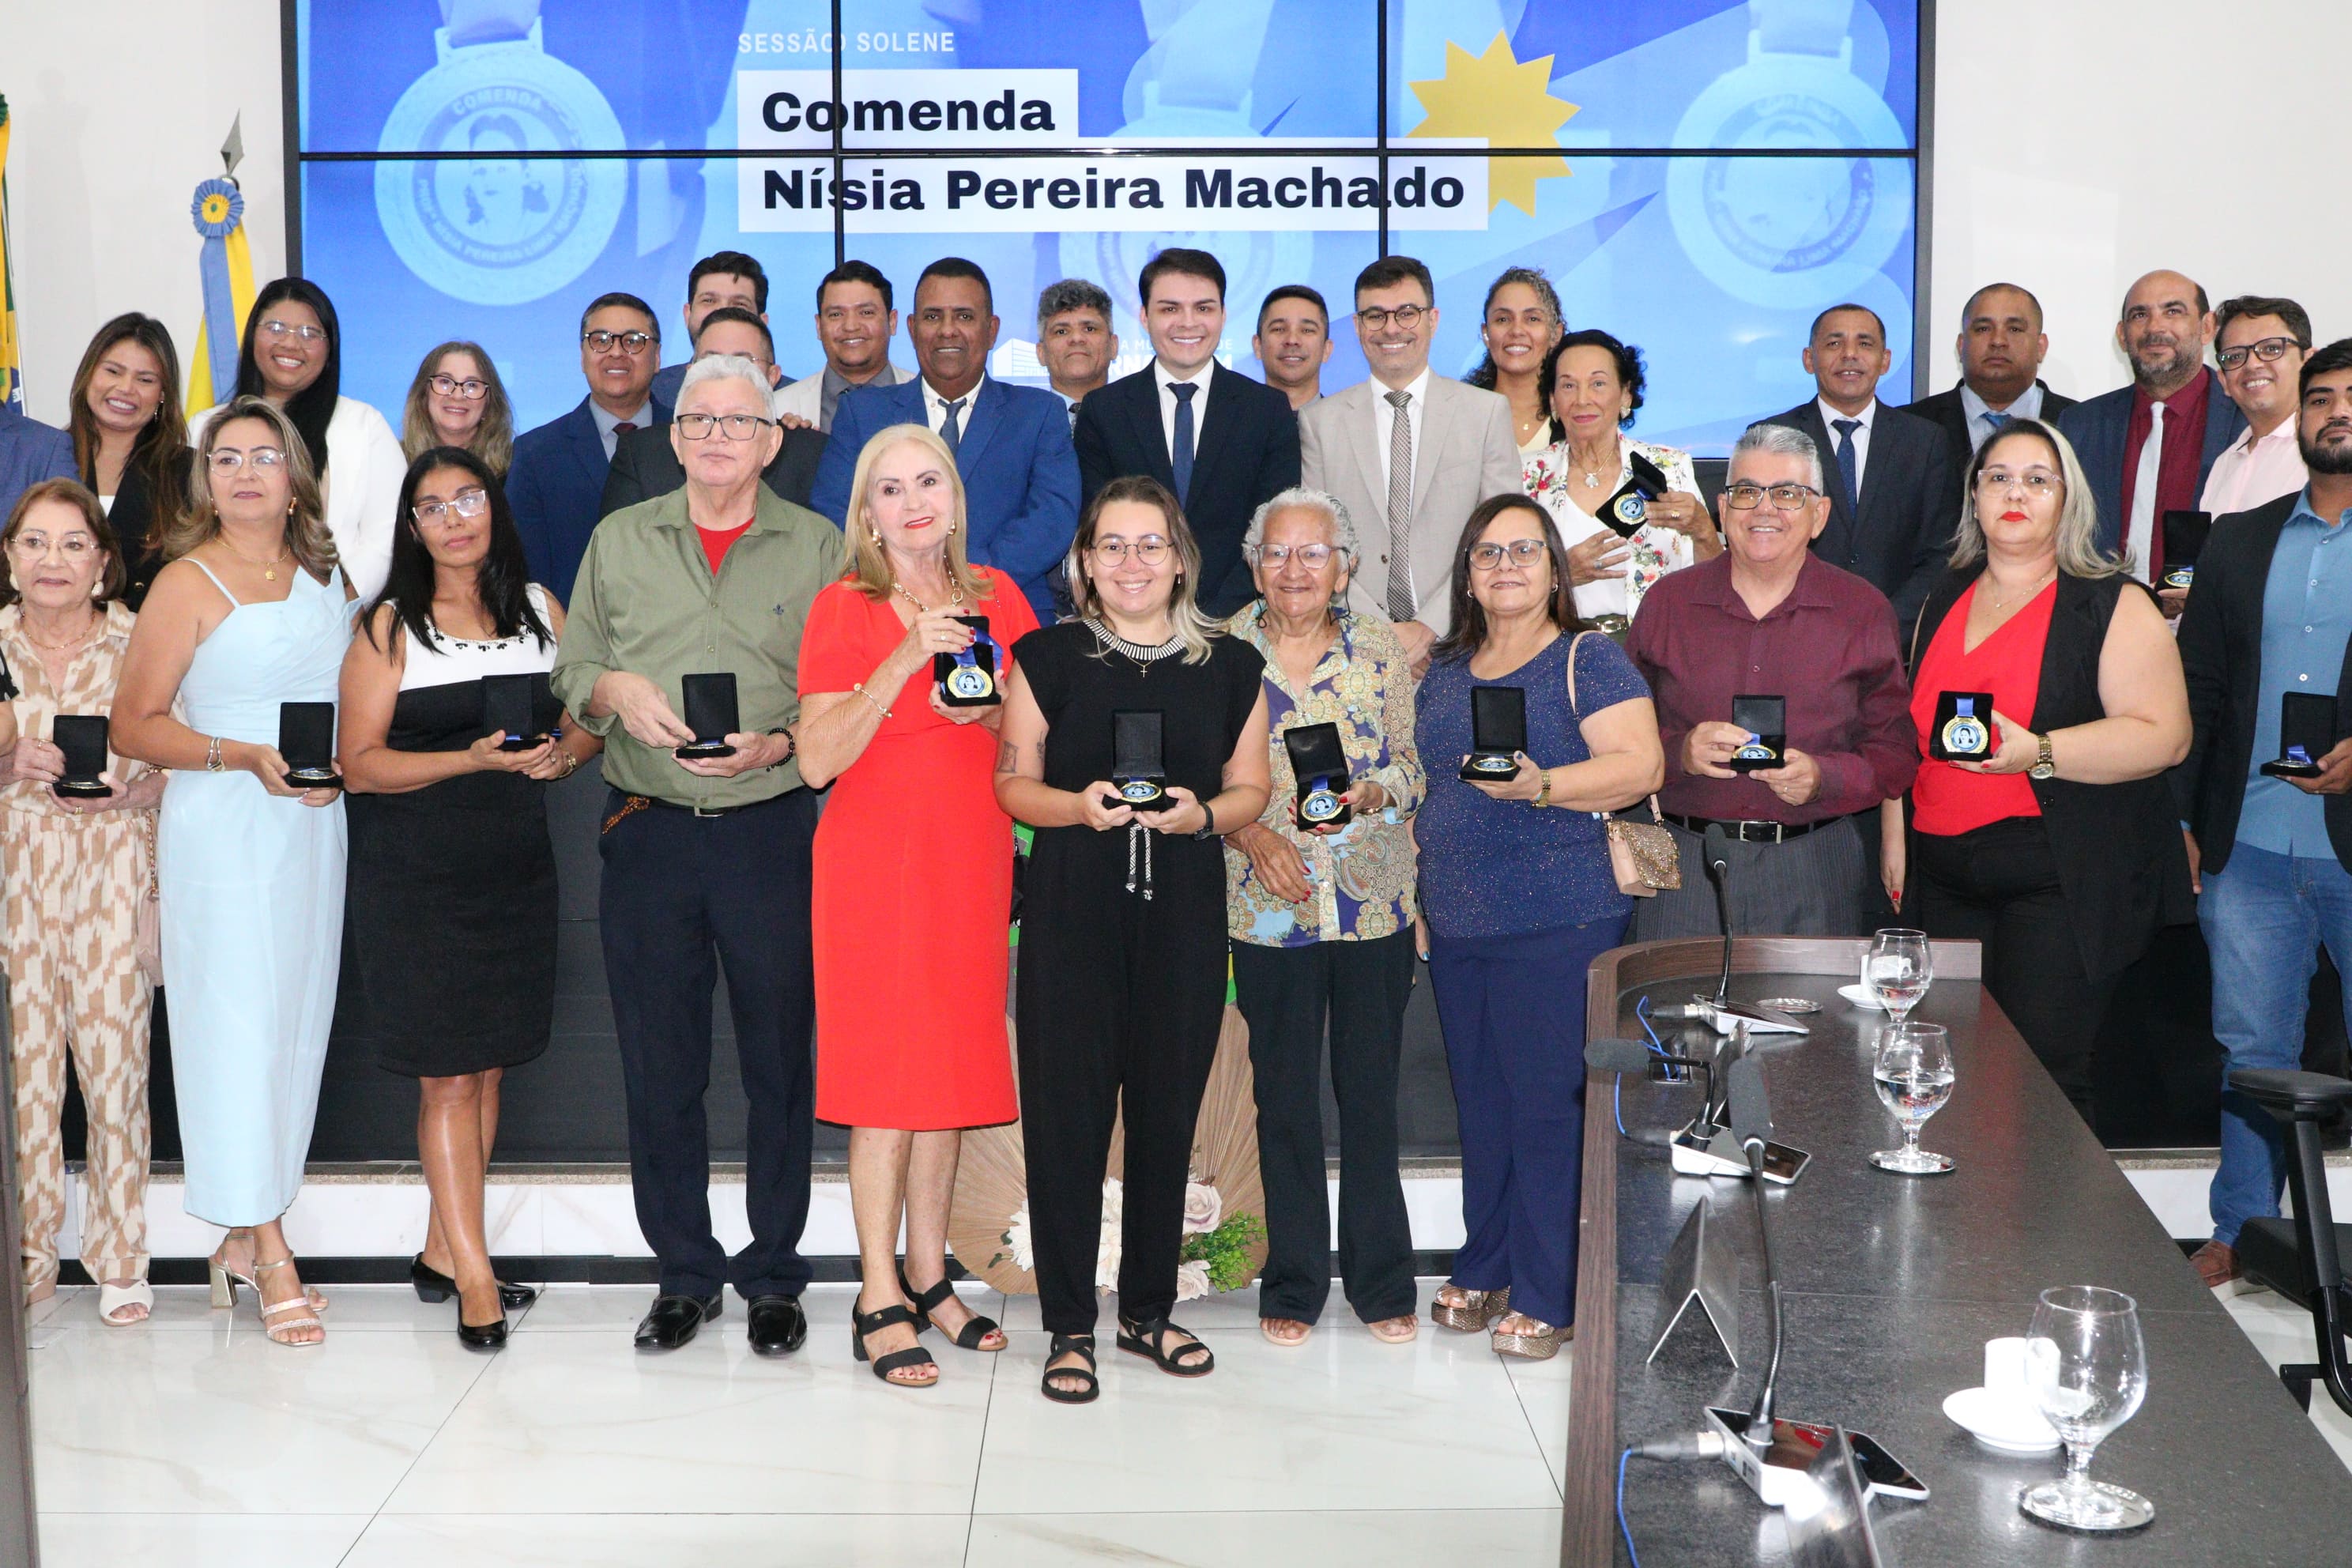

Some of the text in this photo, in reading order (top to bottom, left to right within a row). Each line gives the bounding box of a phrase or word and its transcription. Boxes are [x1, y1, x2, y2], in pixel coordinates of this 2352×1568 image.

[738, 28, 955, 53] SESSÃO SOLENE
[763, 89, 1056, 132] Comenda
[764, 167, 1464, 210] Nísia Pereira Machado
